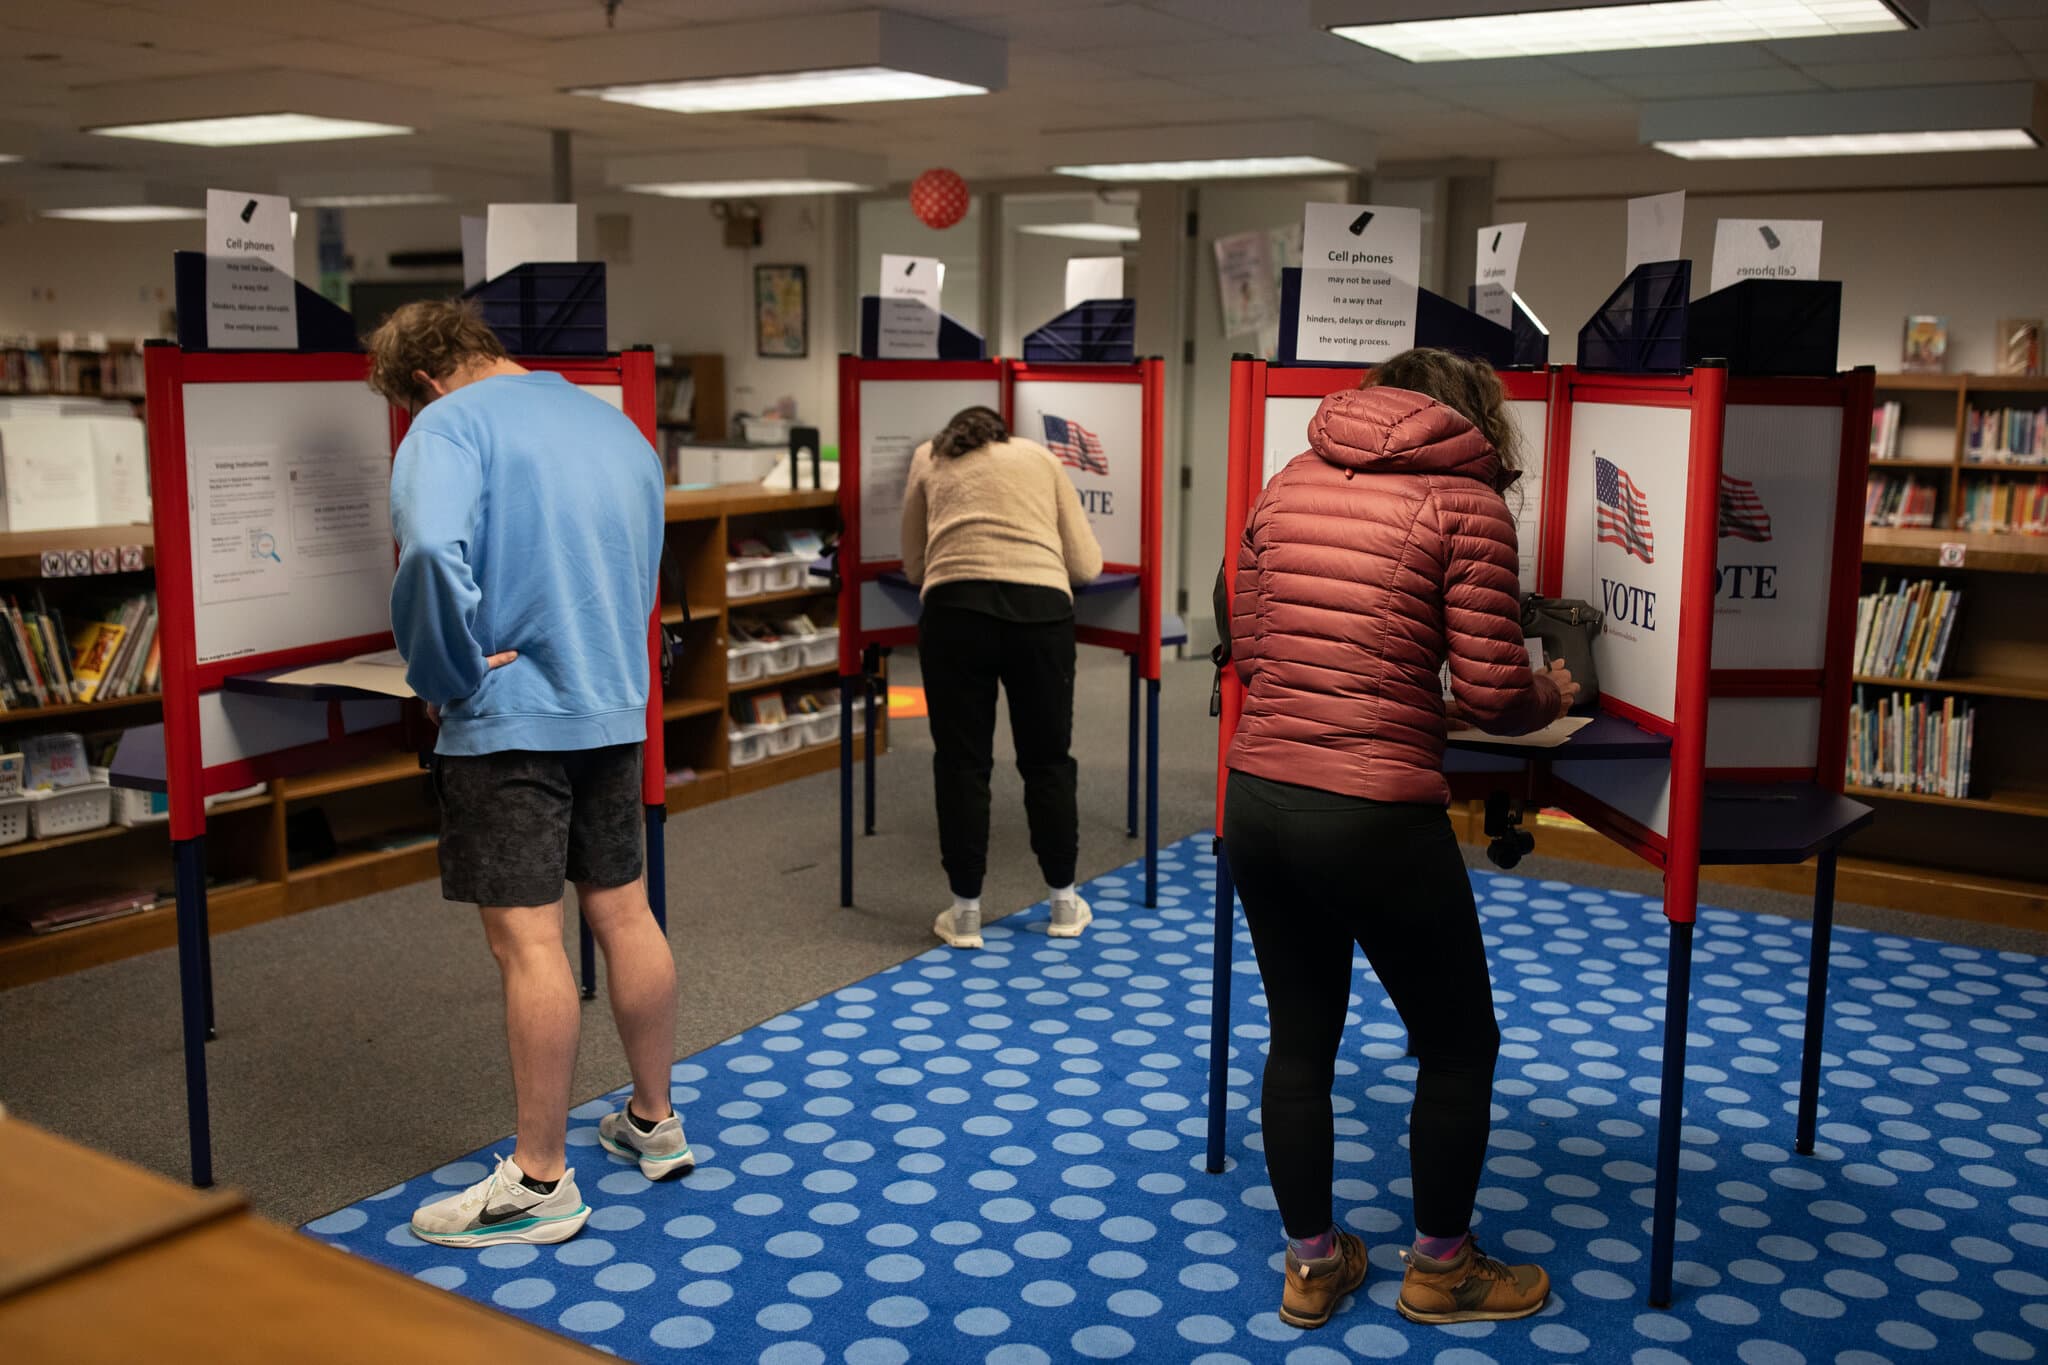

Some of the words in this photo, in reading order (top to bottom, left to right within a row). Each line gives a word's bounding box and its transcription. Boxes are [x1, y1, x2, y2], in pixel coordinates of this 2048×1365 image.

[226, 238, 243, 249] Cell
[244, 239, 275, 251] phones
[1328, 250, 1349, 262] Cell
[1351, 251, 1394, 264] phones
[1328, 277, 1344, 286] may
[1346, 276, 1360, 285] not
[1361, 276, 1371, 285] be
[1373, 277, 1391, 286] used
[1333, 296, 1341, 304] in
[1349, 297, 1365, 306] way
[1366, 296, 1383, 305] that
[1306, 314, 1337, 325] hinders,
[1339, 315, 1364, 327] delays
[1365, 317, 1373, 325] or
[1375, 317, 1406, 329] disrupts
[1319, 336, 1332, 344] the
[1333, 336, 1357, 346] voting
[1359, 337, 1390, 347] process.
[1076, 488, 1113, 515] TE
[47, 558, 59, 569] W
[1715, 565, 1777, 600] TE
[1601, 578, 1656, 631] VOTE
